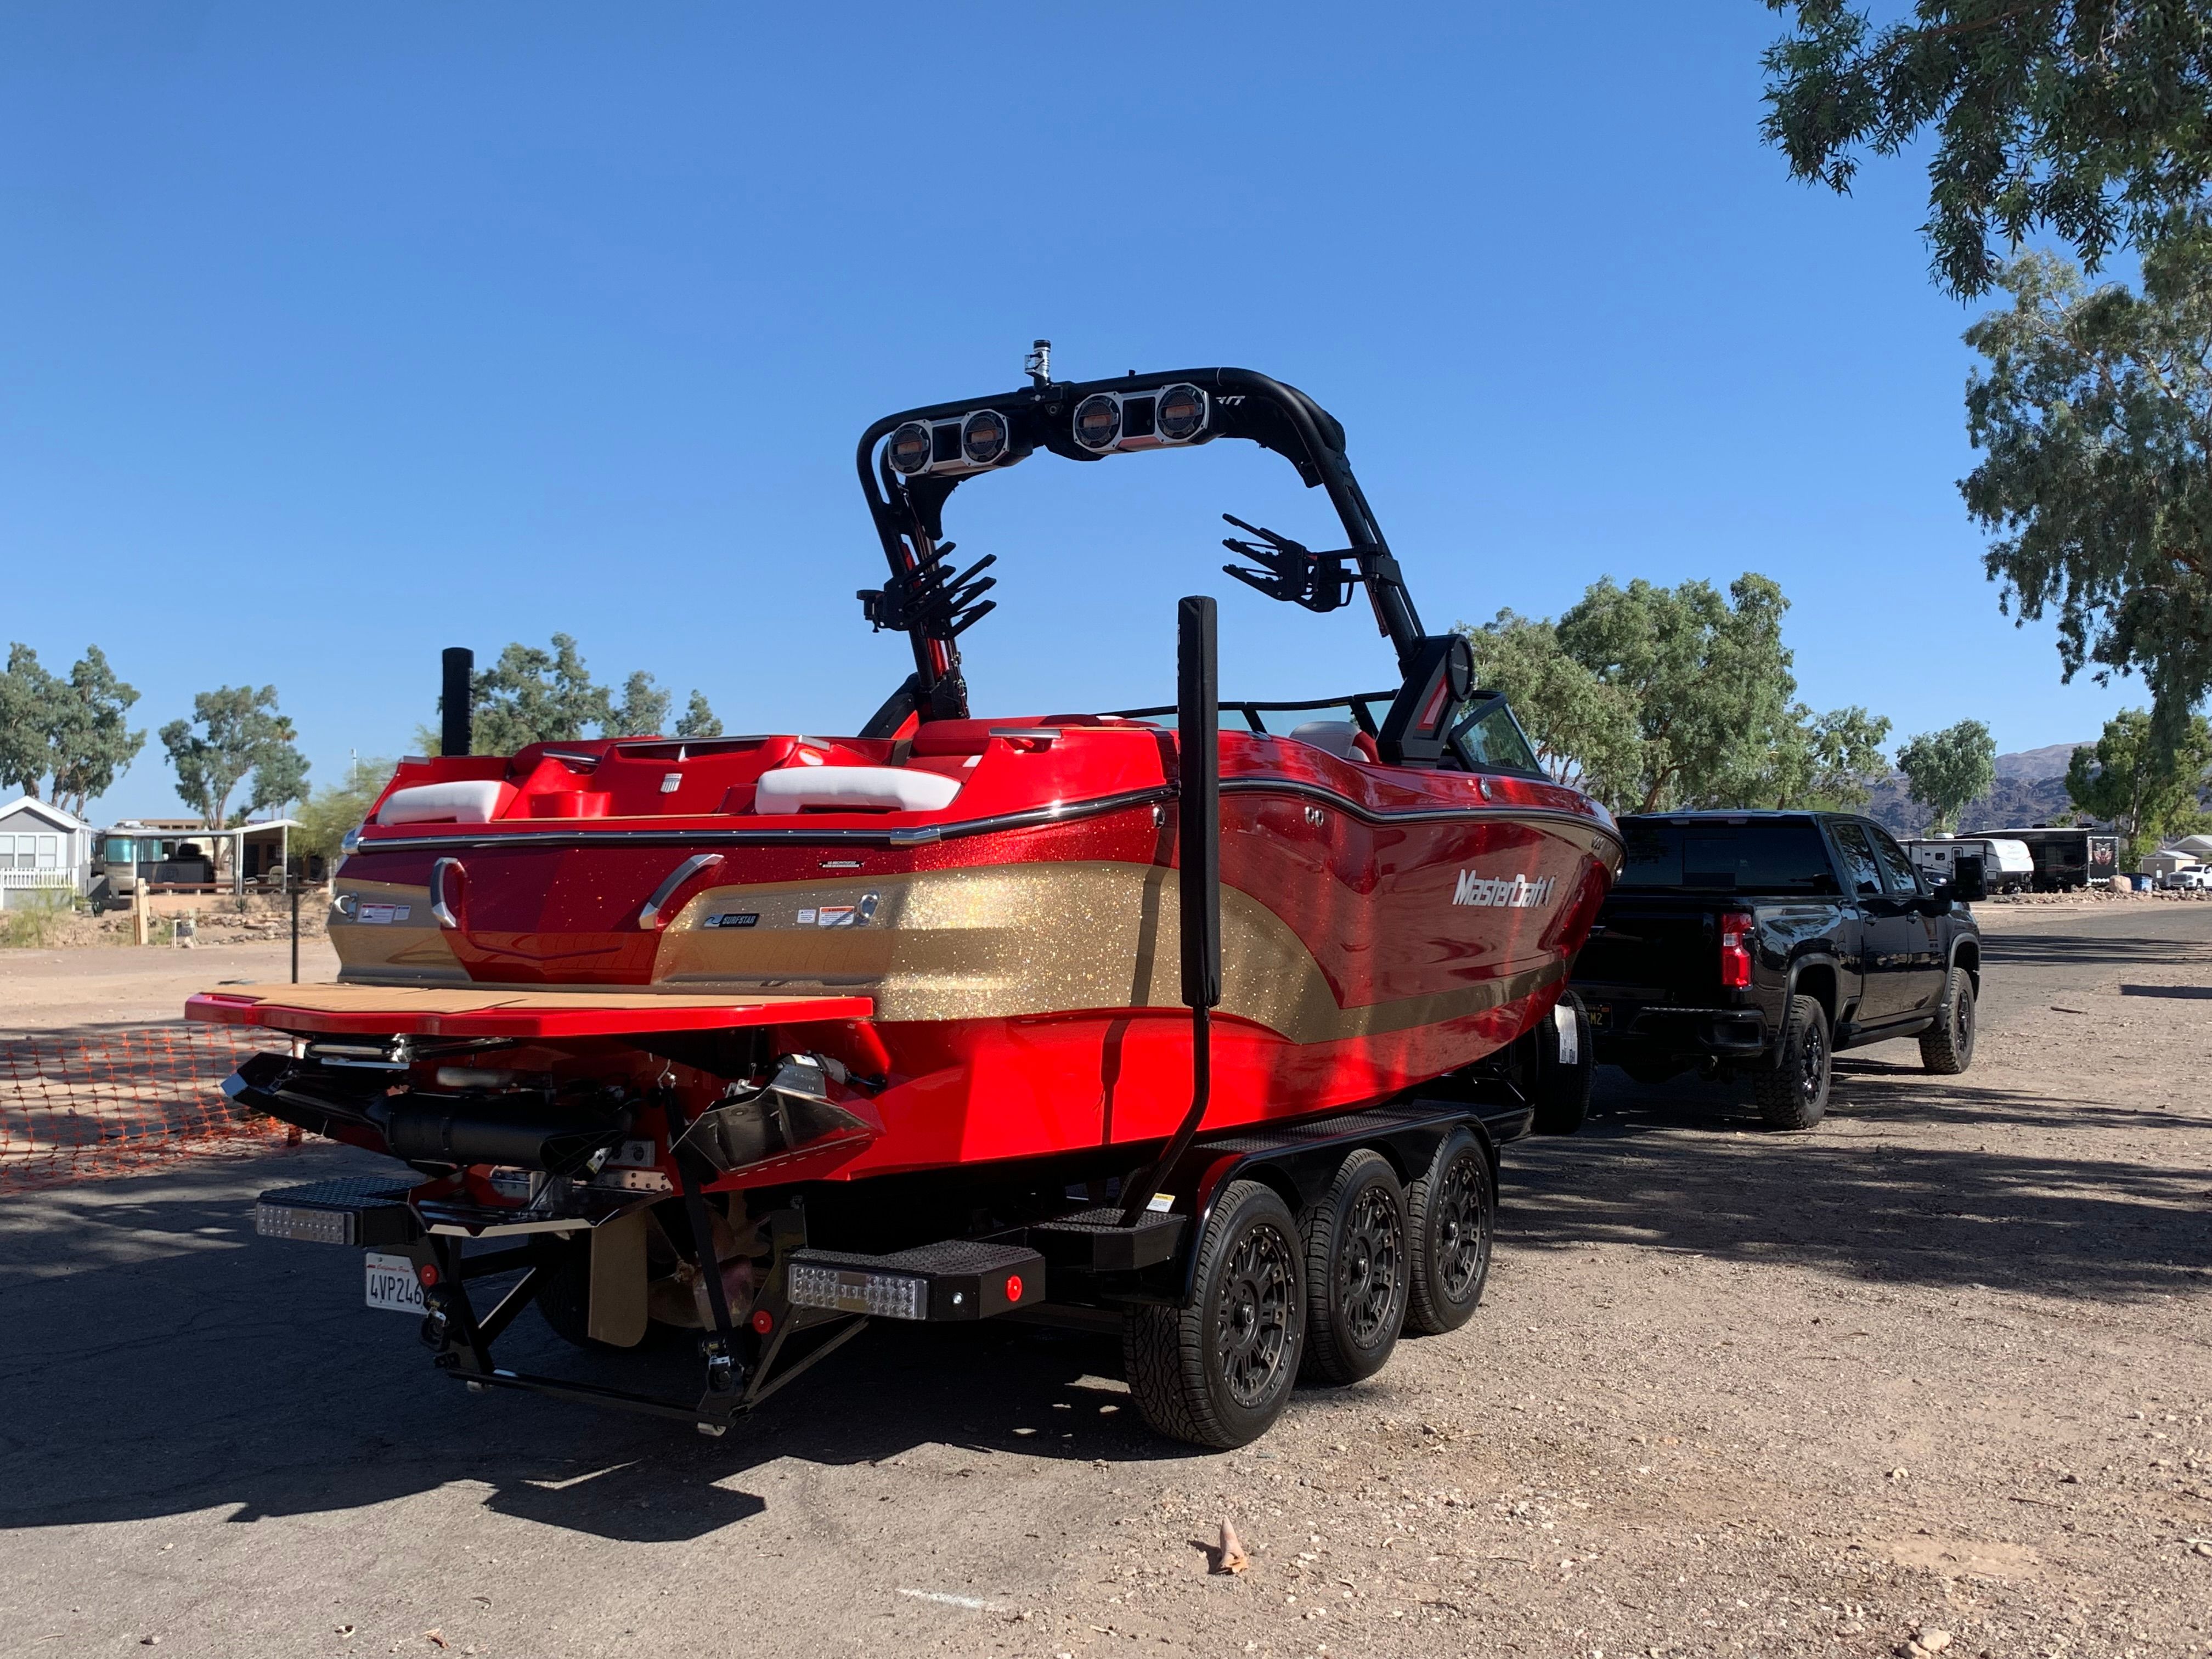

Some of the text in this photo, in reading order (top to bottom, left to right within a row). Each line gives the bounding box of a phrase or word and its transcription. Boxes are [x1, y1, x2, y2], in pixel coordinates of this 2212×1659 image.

[1452, 869, 1547, 907] MasterCraft
[722, 916, 756, 925] SURFSTAR
[1588, 1012, 1602, 1025] M2
[370, 1274, 422, 1305] 4VP246
